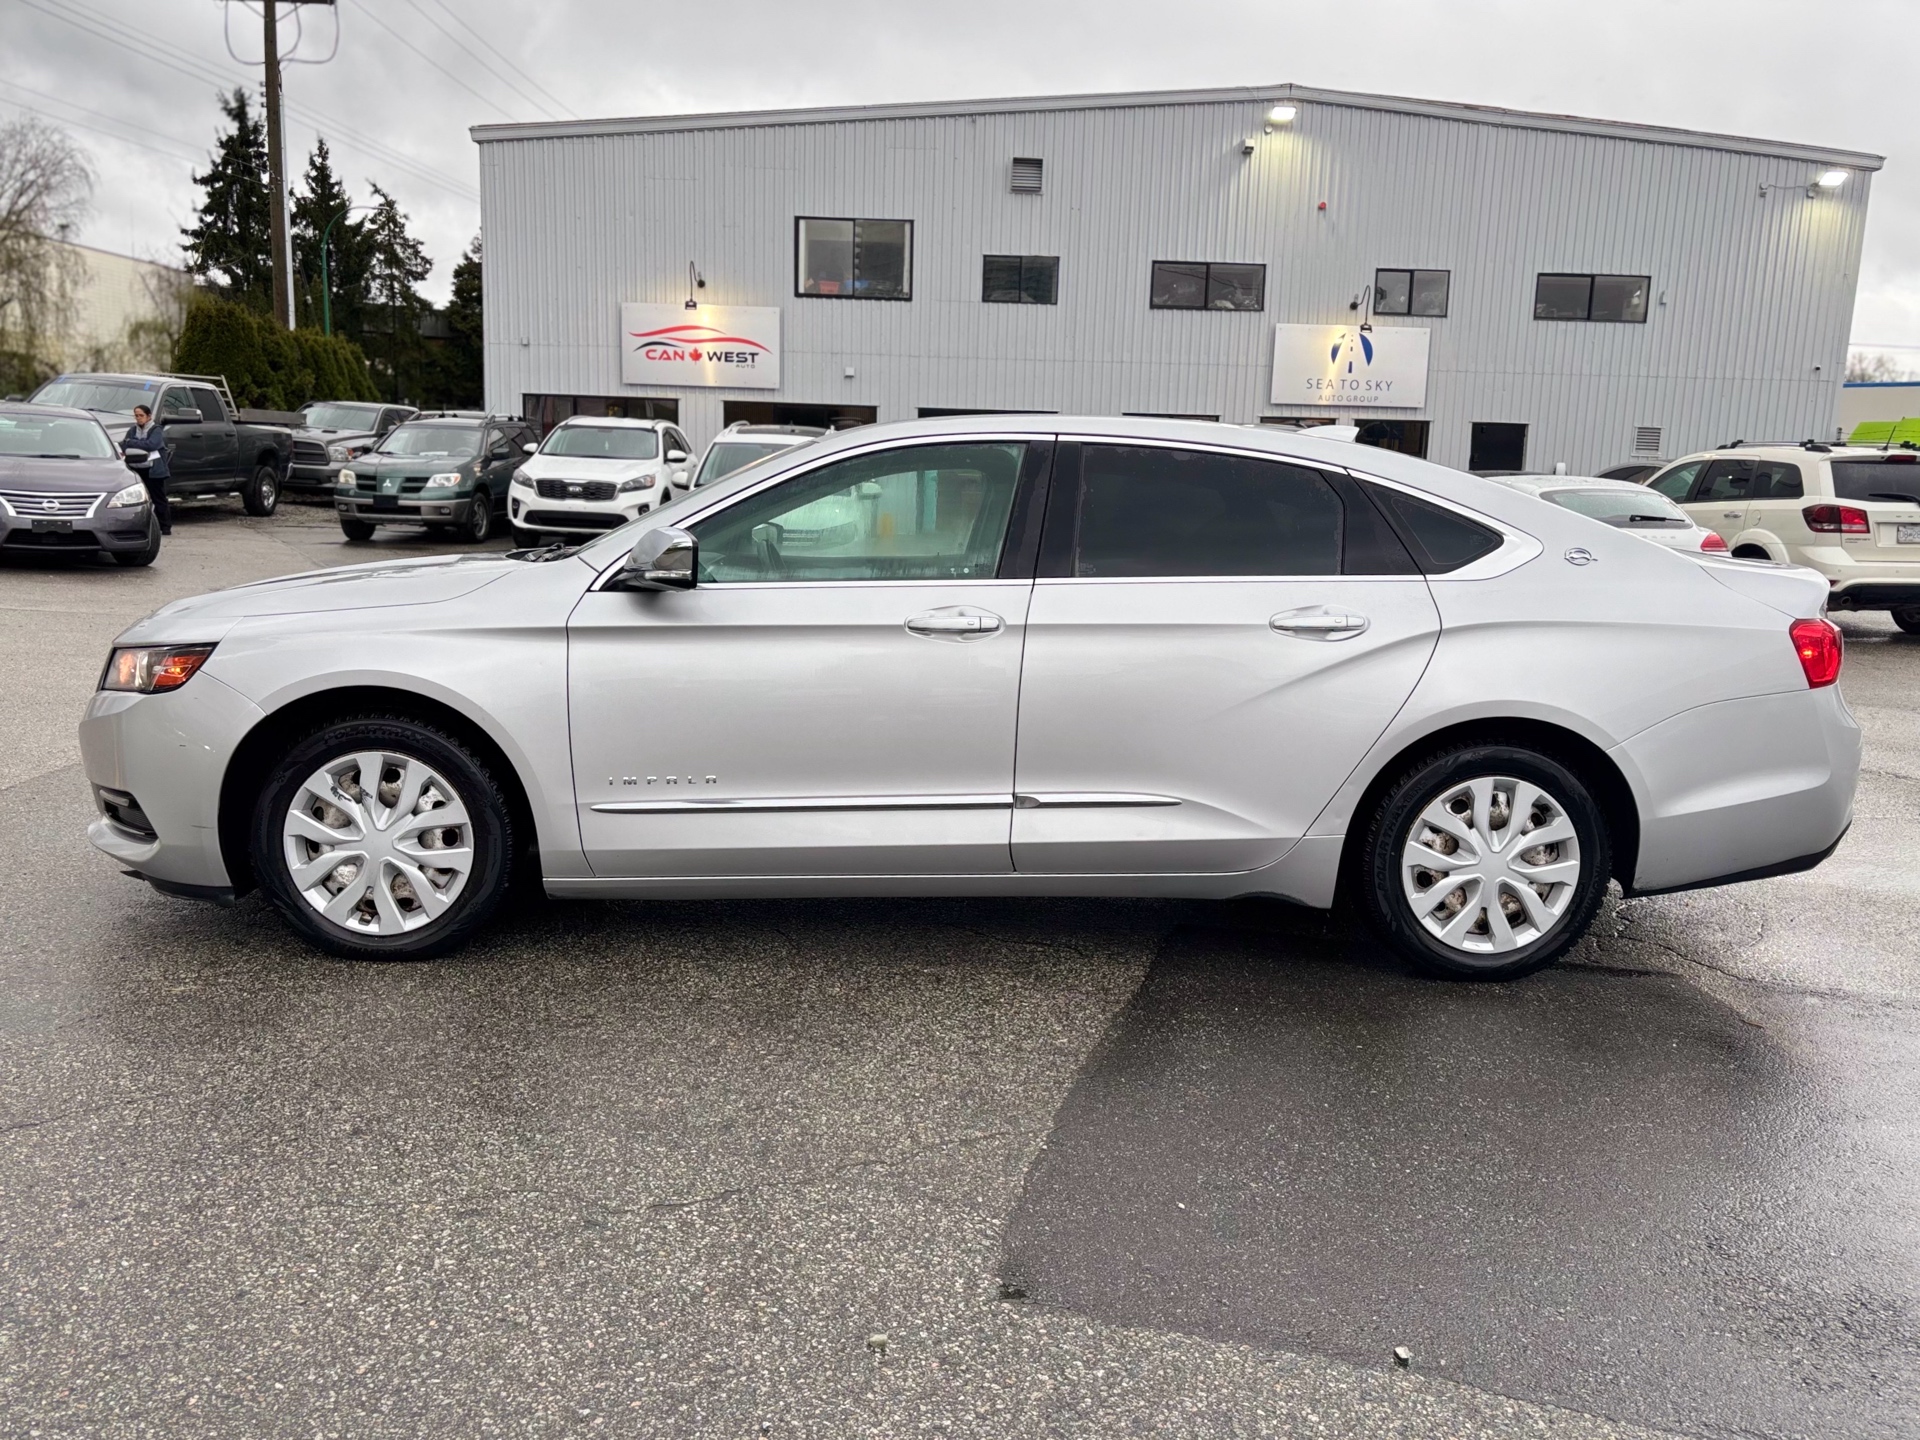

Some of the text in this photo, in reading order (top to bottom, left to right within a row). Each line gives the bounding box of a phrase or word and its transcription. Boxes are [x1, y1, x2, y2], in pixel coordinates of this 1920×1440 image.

[645, 349, 759, 363] CAN WEST
[1306, 378, 1393, 392] SEA TO SKY
[1346, 395, 1379, 403] GROUP
[608, 775, 717, 785] IMPALA
